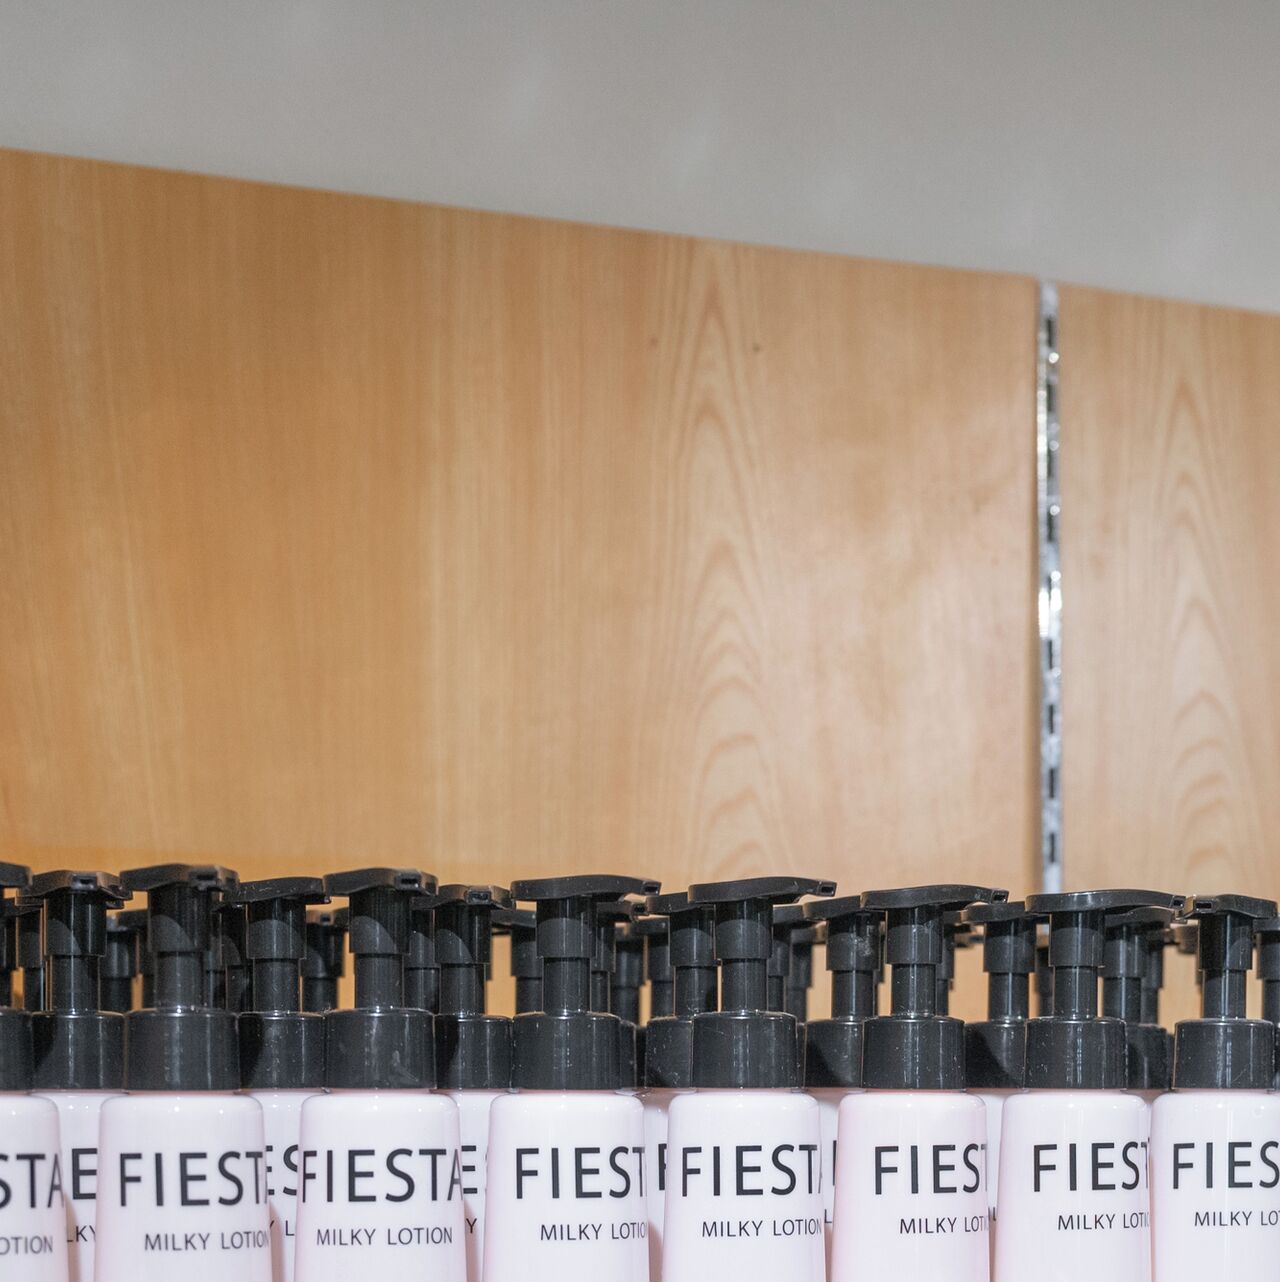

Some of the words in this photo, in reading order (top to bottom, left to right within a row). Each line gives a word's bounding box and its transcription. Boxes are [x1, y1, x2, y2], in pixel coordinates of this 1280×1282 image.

[120, 1151, 268, 1207] FIEST
[301, 1148, 463, 1203] FIESTA
[899, 1217, 957, 1235] MILKY
[1058, 1213, 1116, 1230] MILKY
[1194, 1210, 1253, 1228] MILKY
[317, 1228, 376, 1246] MILKY
[387, 1226, 453, 1246] LOTION
[540, 1223, 603, 1241] MILKY
[702, 1220, 763, 1238] MILKY
[144, 1232, 210, 1252] MILKY
